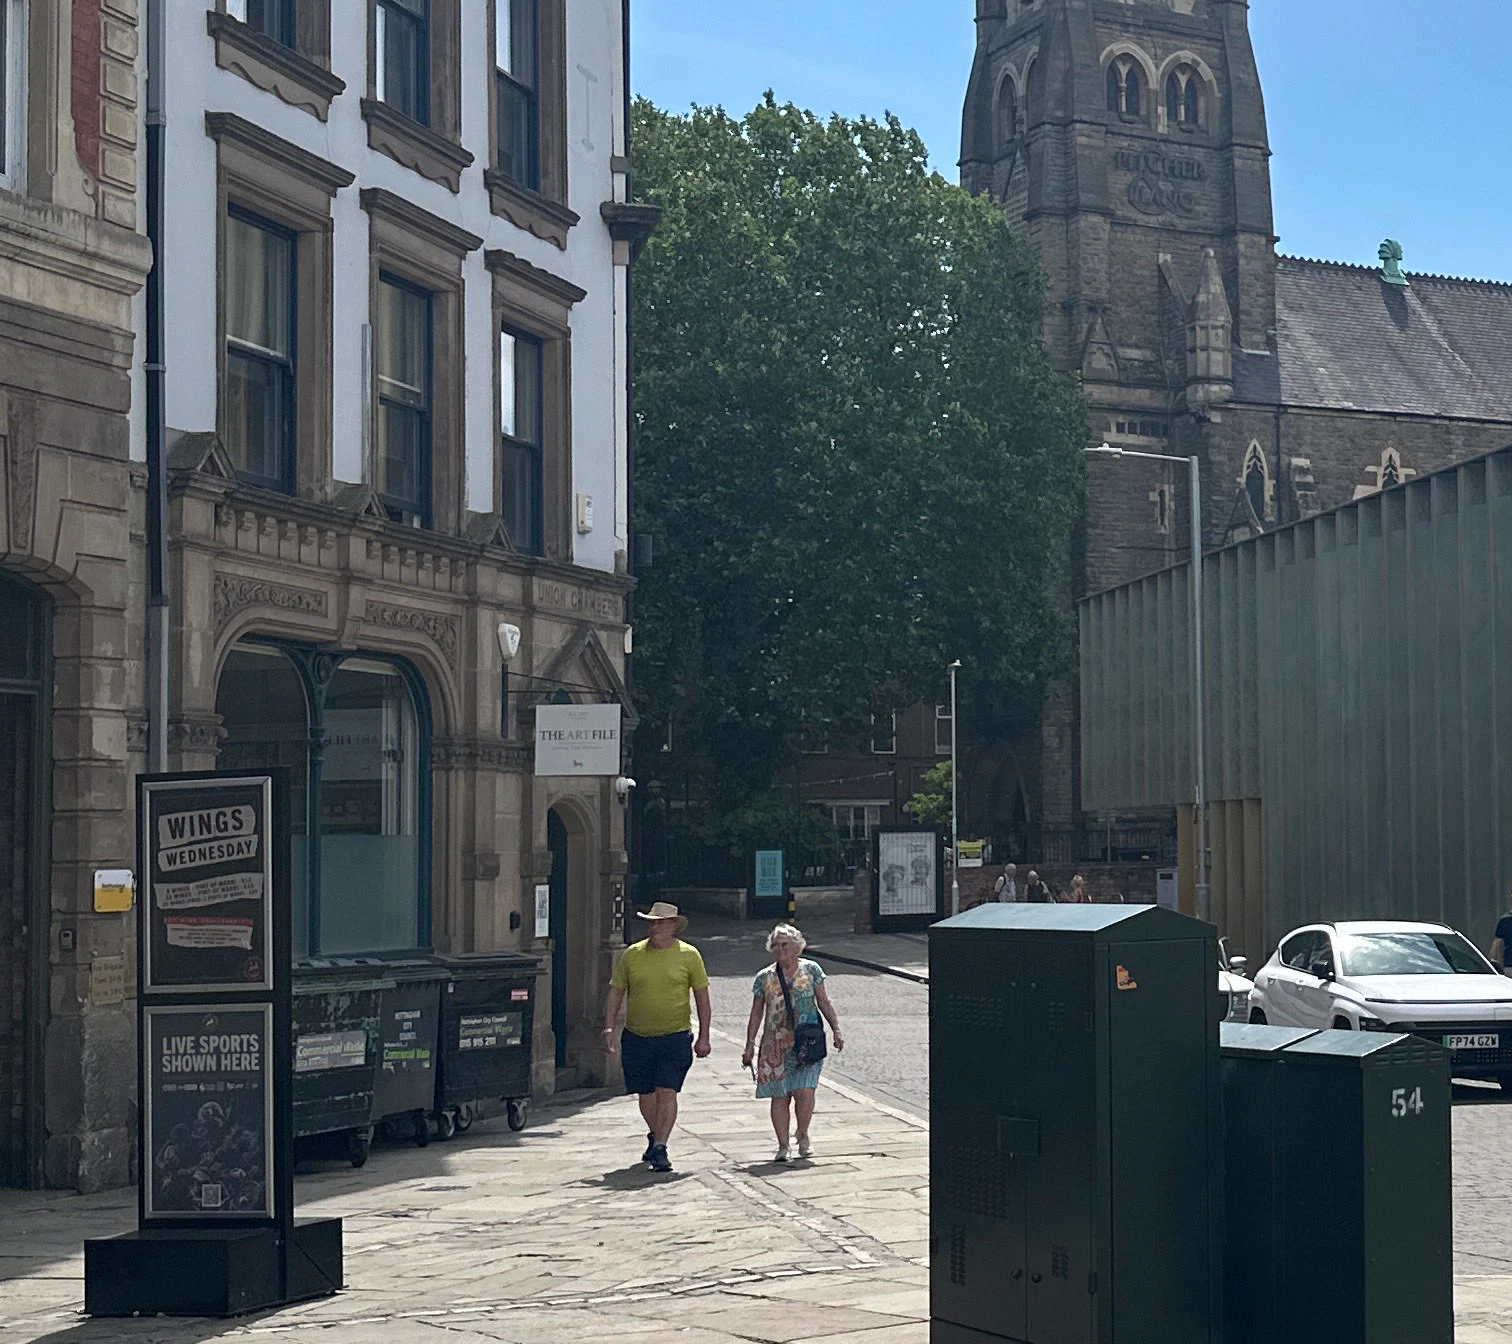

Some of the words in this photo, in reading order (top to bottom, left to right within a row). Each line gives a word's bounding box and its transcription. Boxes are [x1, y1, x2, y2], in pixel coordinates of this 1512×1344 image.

[540, 730, 565, 741] THE
[567, 730, 590, 740] ART
[592, 729, 617, 740] FILE
[167, 808, 244, 840] WINGS
[166, 840, 252, 867] WEDNESDAY
[162, 1036, 196, 1054] LIVE
[199, 1033, 259, 1054] SPORTS
[1450, 1036, 1475, 1047] FP74
[162, 1054, 217, 1072] SHOWN
[221, 1053, 260, 1071] HERE
[1391, 1086, 1424, 1118] 54
